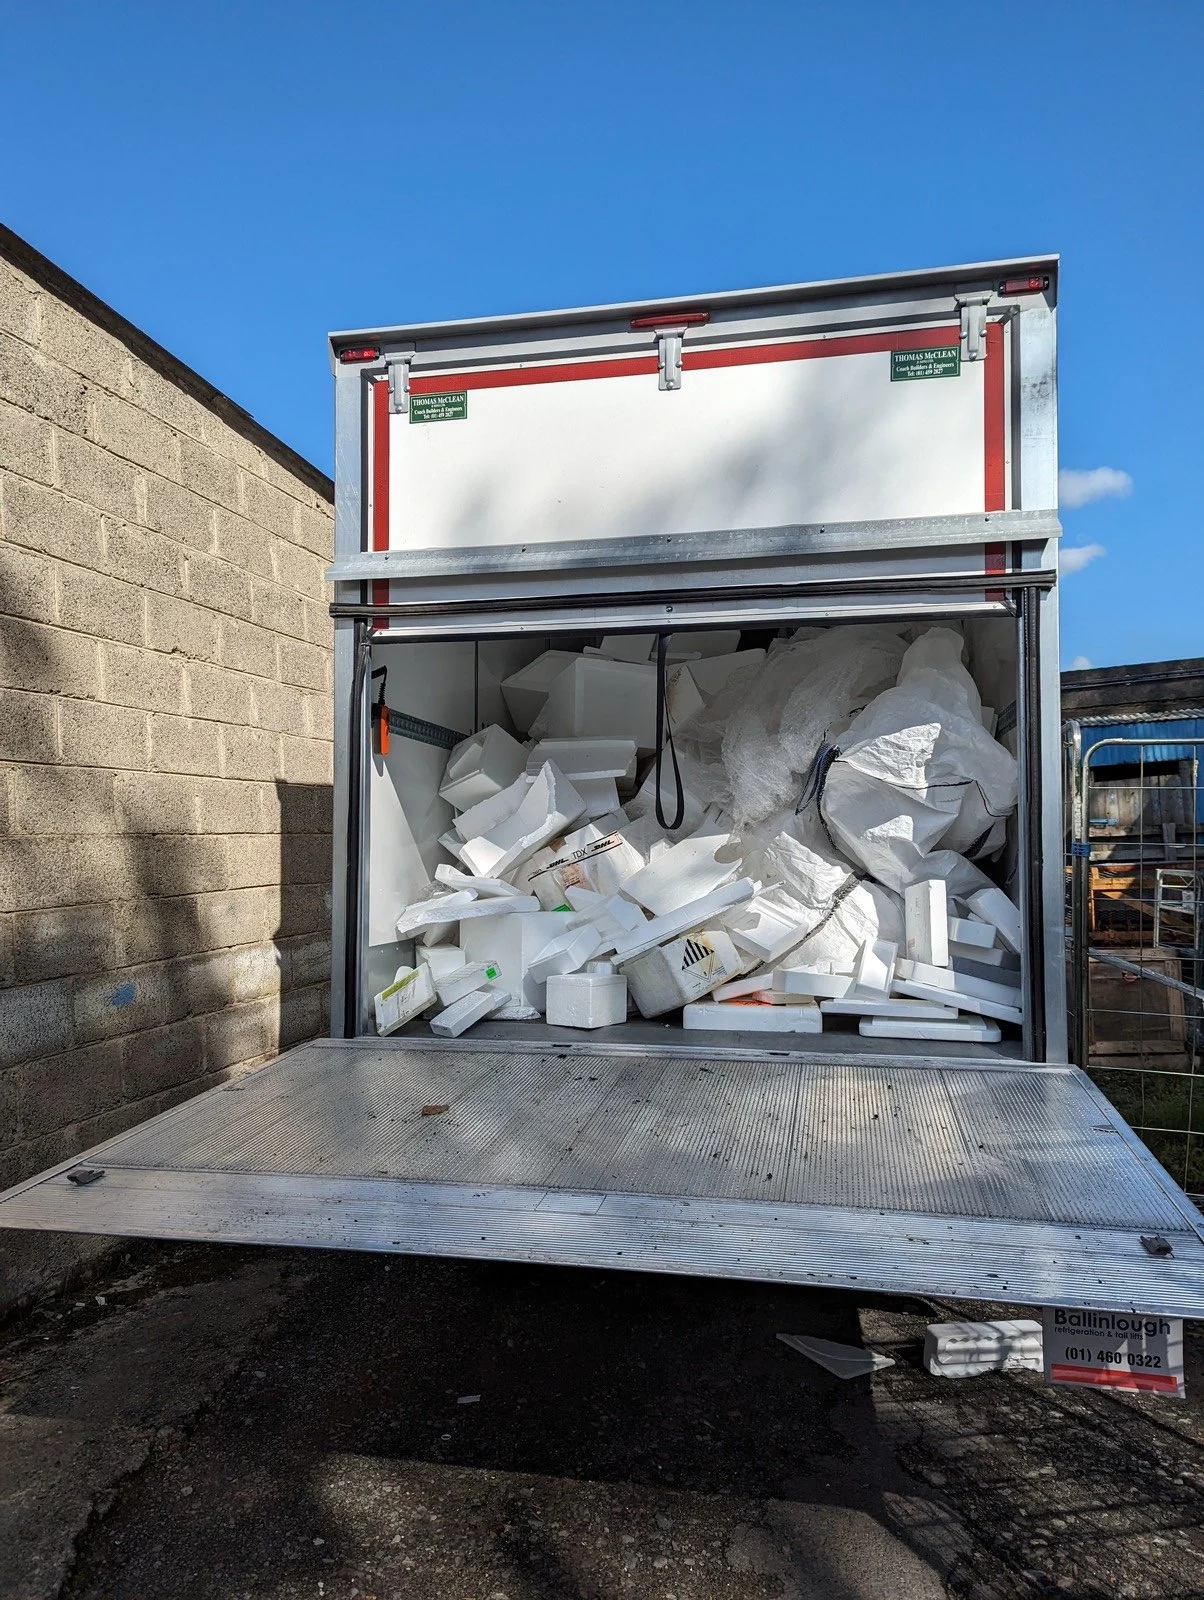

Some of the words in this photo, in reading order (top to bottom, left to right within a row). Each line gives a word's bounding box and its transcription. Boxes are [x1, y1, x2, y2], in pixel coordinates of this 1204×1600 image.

[895, 353, 923, 362] THOMAS
[925, 350, 956, 359] McCLEAN
[413, 398, 436, 406] THOMAS
[438, 395, 463, 404] McCLEAN
[546, 858, 569, 869] DHL
[572, 848, 588, 859] TDX
[591, 840, 614, 852] DHL
[1054, 1308, 1170, 1337] Ballinlough
[1054, 1326, 1104, 1338] refrigeration
[1130, 1332, 1143, 1340] lifts
[1065, 1346, 1092, 1362] (01)
[1097, 1350, 1122, 1364] 460
[1128, 1353, 1162, 1368] 0322
